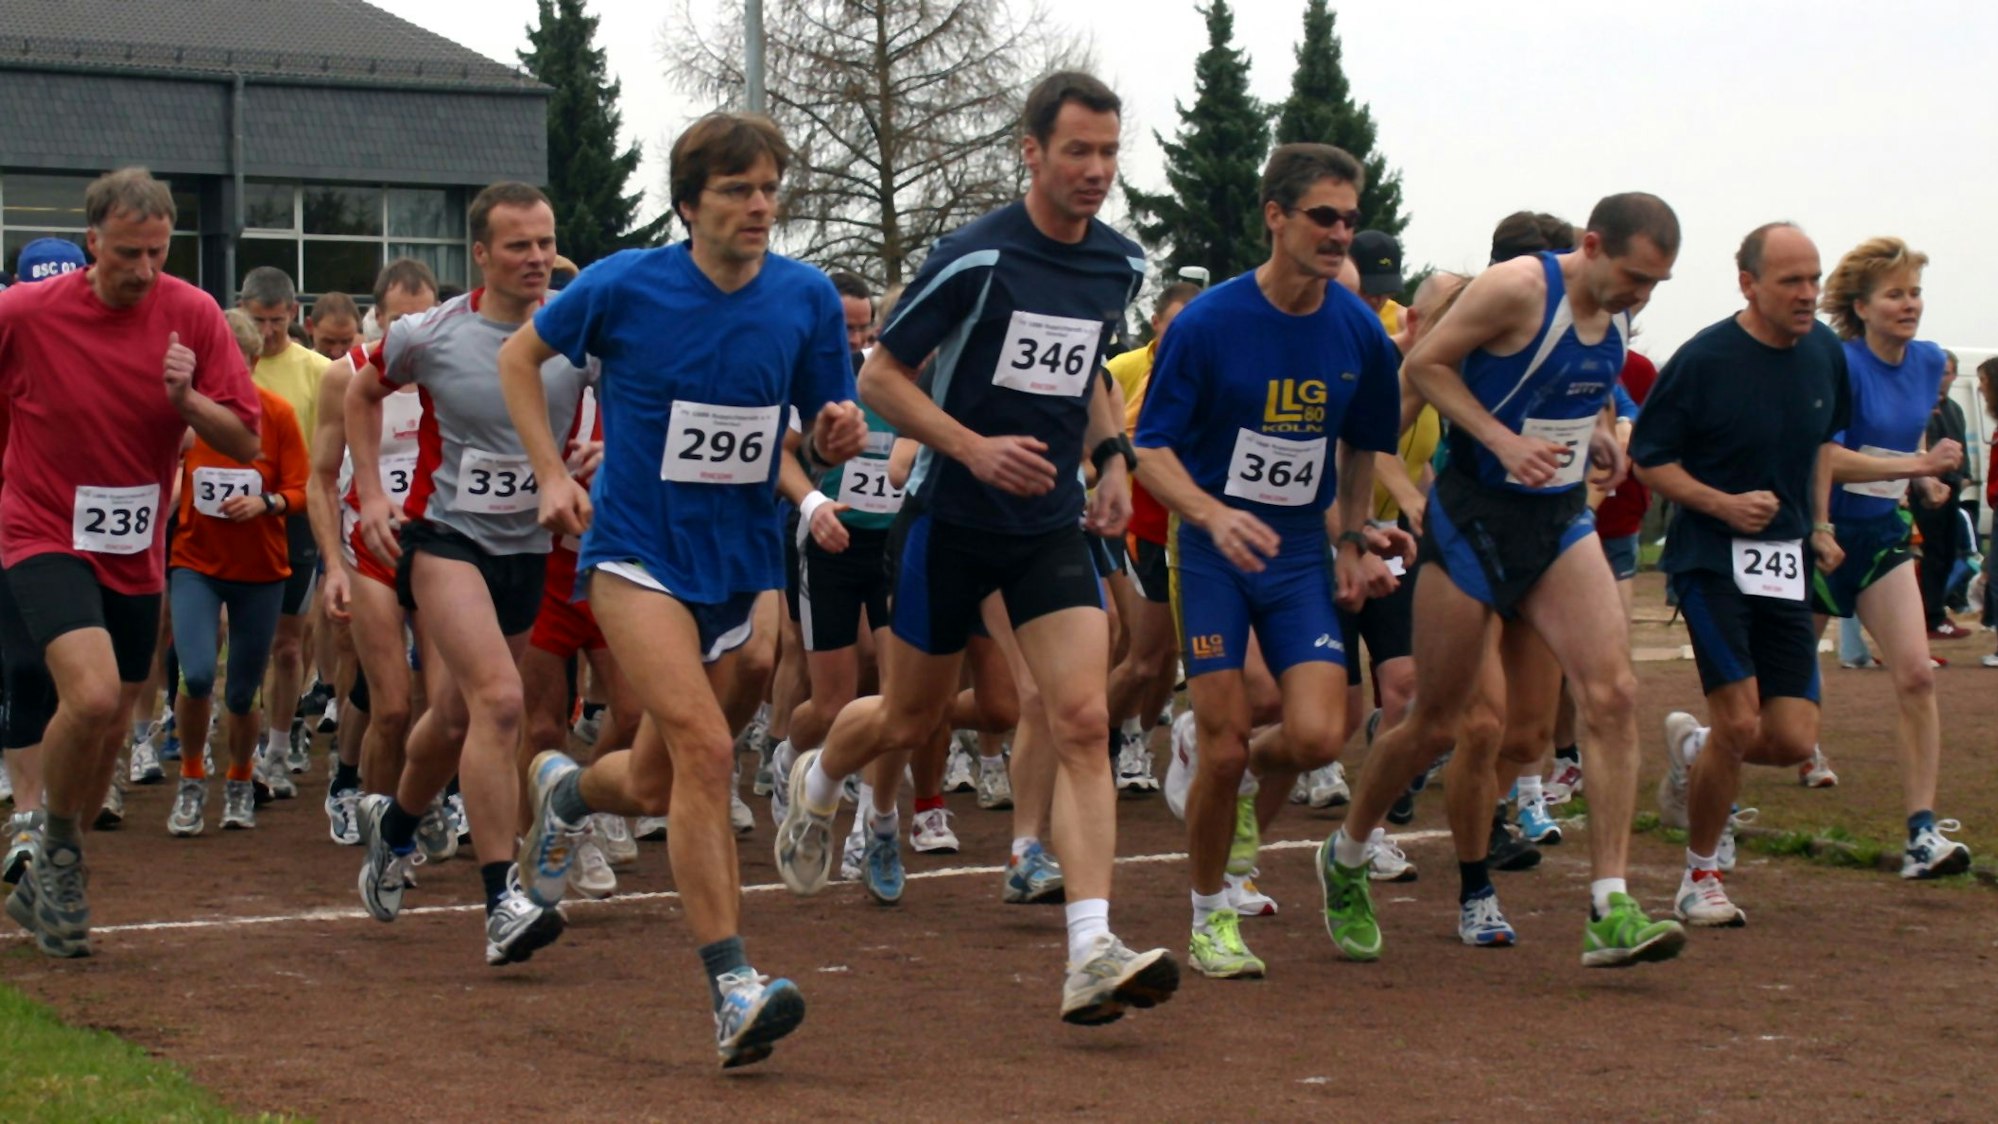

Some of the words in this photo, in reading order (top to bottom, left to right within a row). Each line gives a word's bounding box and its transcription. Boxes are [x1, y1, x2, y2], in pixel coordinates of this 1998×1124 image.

[32, 261, 59, 279] BSC
[1011, 338, 1086, 376] 346
[1264, 378, 1328, 422] LLG
[1303, 406, 1325, 422] 80
[679, 428, 764, 463] 296
[390, 469, 417, 493] 3
[468, 469, 538, 497] 334
[850, 472, 902, 498] 21
[1240, 453, 1314, 488] 364
[201, 481, 249, 502] 371
[84, 506, 151, 536] 238
[1744, 548, 1797, 580] 243
